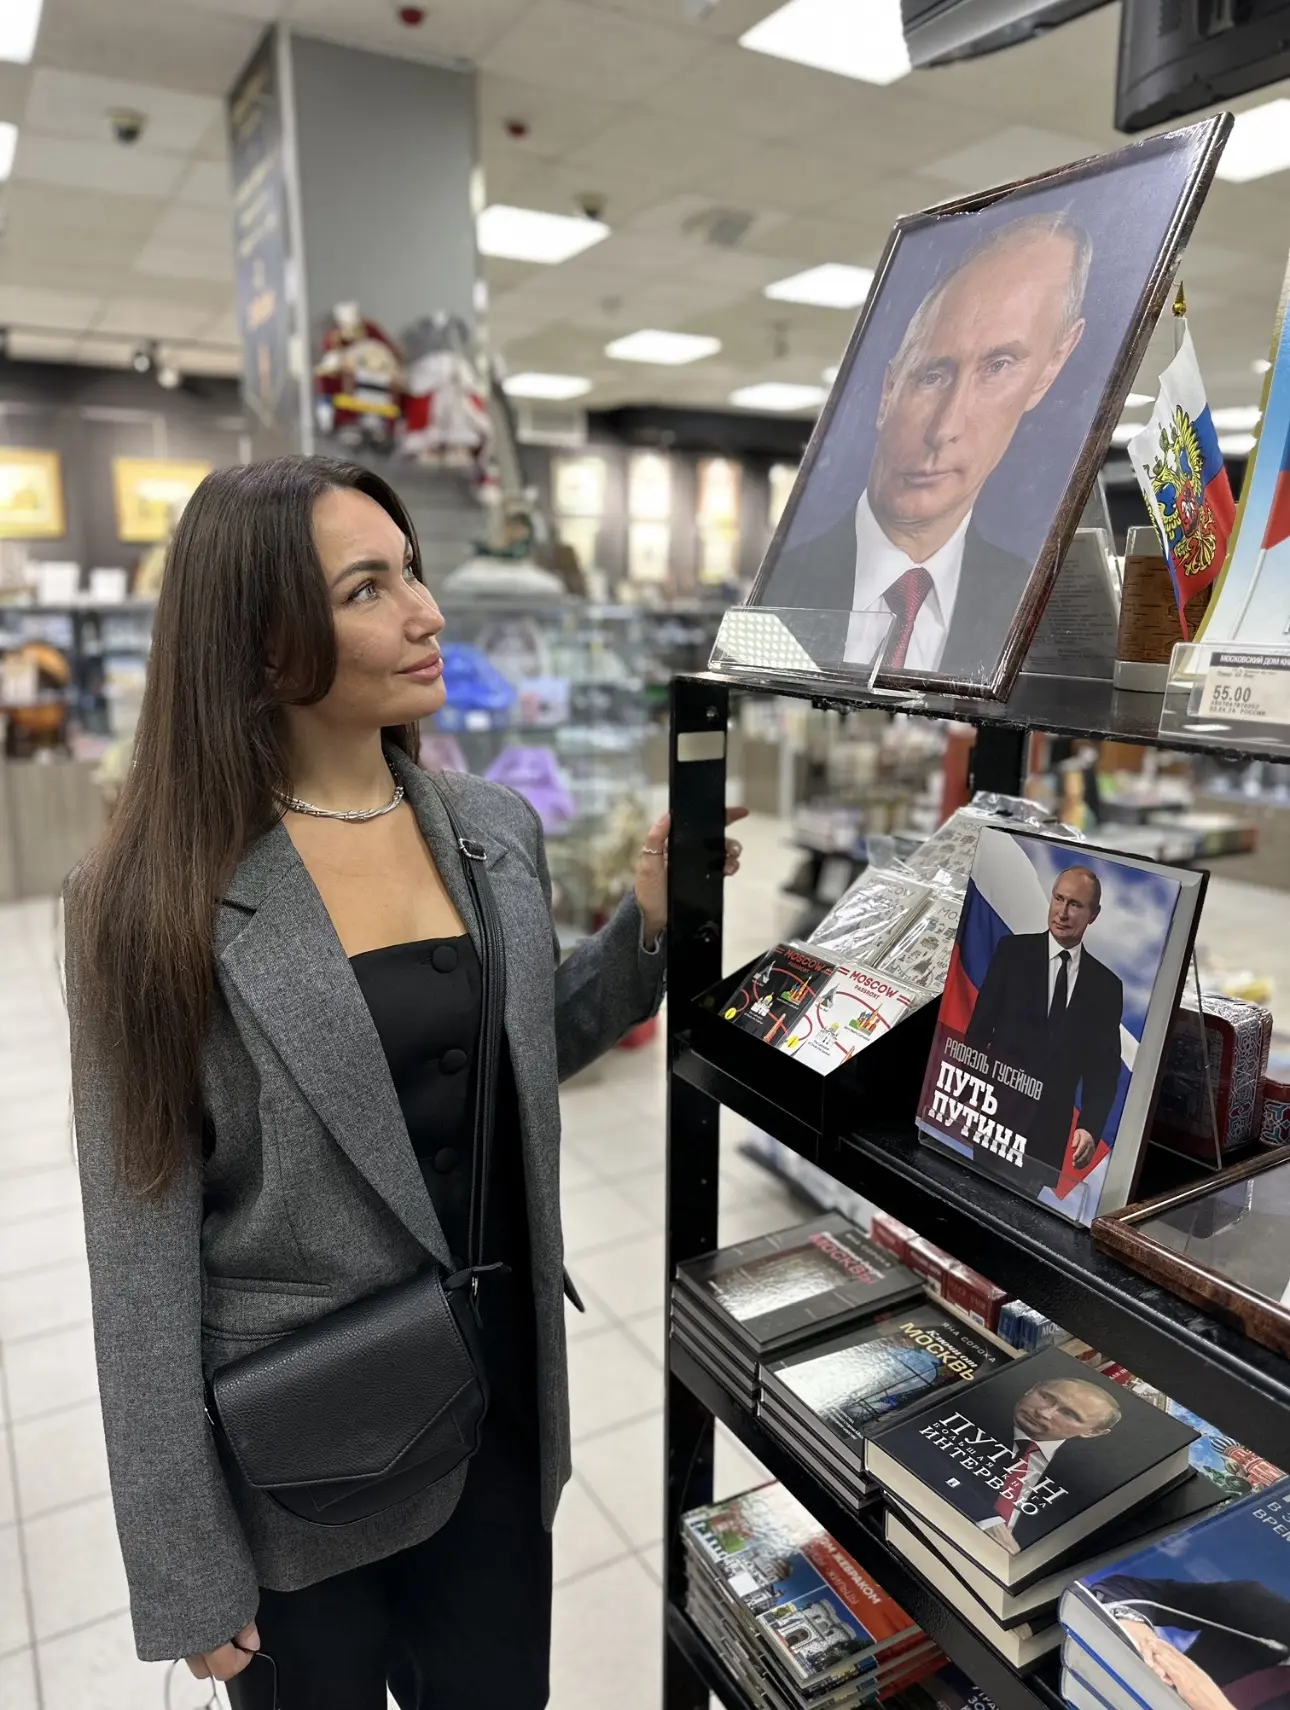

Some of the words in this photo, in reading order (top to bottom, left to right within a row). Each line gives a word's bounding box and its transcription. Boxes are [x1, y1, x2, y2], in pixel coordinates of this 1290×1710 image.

[1219, 654, 1264, 664] МОСКОВСКИЙ
[1263, 656, 1280, 666] ДОМ
[1212, 684, 1252, 702] 55.00
[784, 949, 825, 972] MOSCOW
[849, 970, 898, 998] MOSCOW
[936, 1060, 998, 1116] ПУТЬ
[944, 1036, 990, 1075] РАФАЭЛЬ
[991, 1060, 1044, 1101] ГУСЕЙНОВ
[927, 1089, 1028, 1168] ПУТИНА
[941, 1321, 960, 1337] ЯНА
[919, 1426, 1039, 1515] ИНТЕРВЬЮ
[932, 1422, 995, 1468] БОЛЬШАЯ
[1001, 1473, 1047, 1508] КНИГА
[939, 1411, 1069, 1505] ПУТИН
[1267, 1501, 1282, 1512] В
